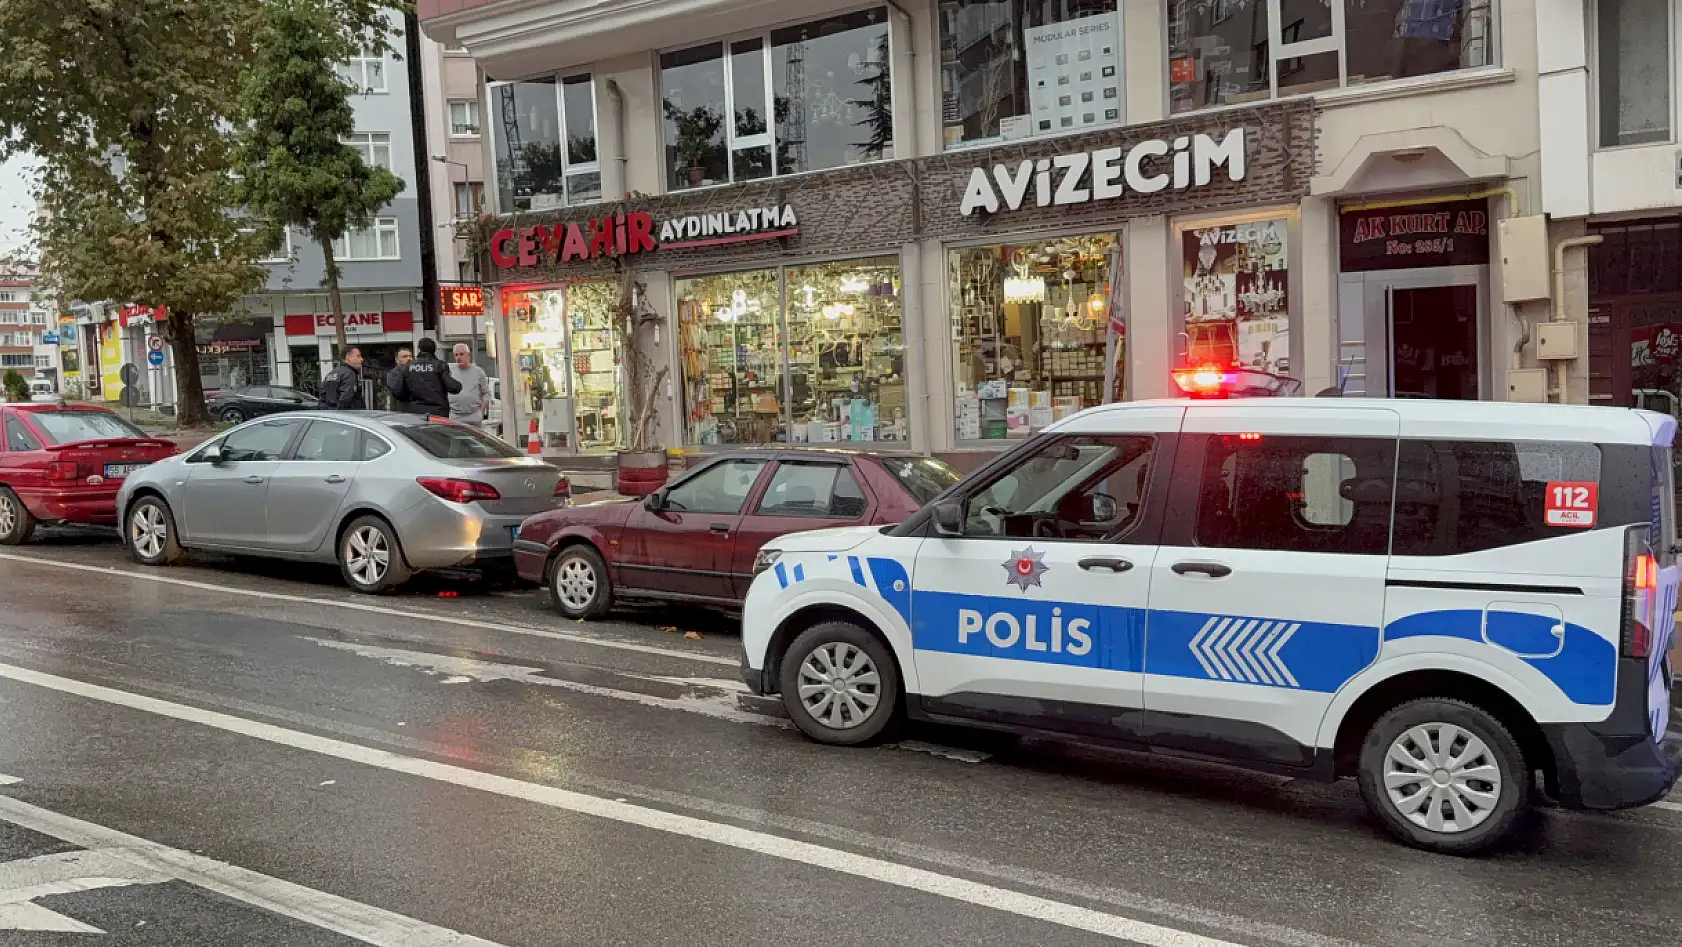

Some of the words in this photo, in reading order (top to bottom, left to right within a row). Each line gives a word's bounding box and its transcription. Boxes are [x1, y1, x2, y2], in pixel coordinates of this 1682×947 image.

[1033, 28, 1077, 44] MODULAR
[1078, 21, 1110, 36] SERIES
[660, 204, 797, 241] AYDINLATMA
[1353, 217, 1385, 243] AK
[1389, 211, 1450, 236] KURT
[1454, 210, 1487, 235] AP.
[316, 312, 380, 327] ECANE
[1553, 486, 1589, 508] 112
[958, 606, 1092, 655] POLİS
